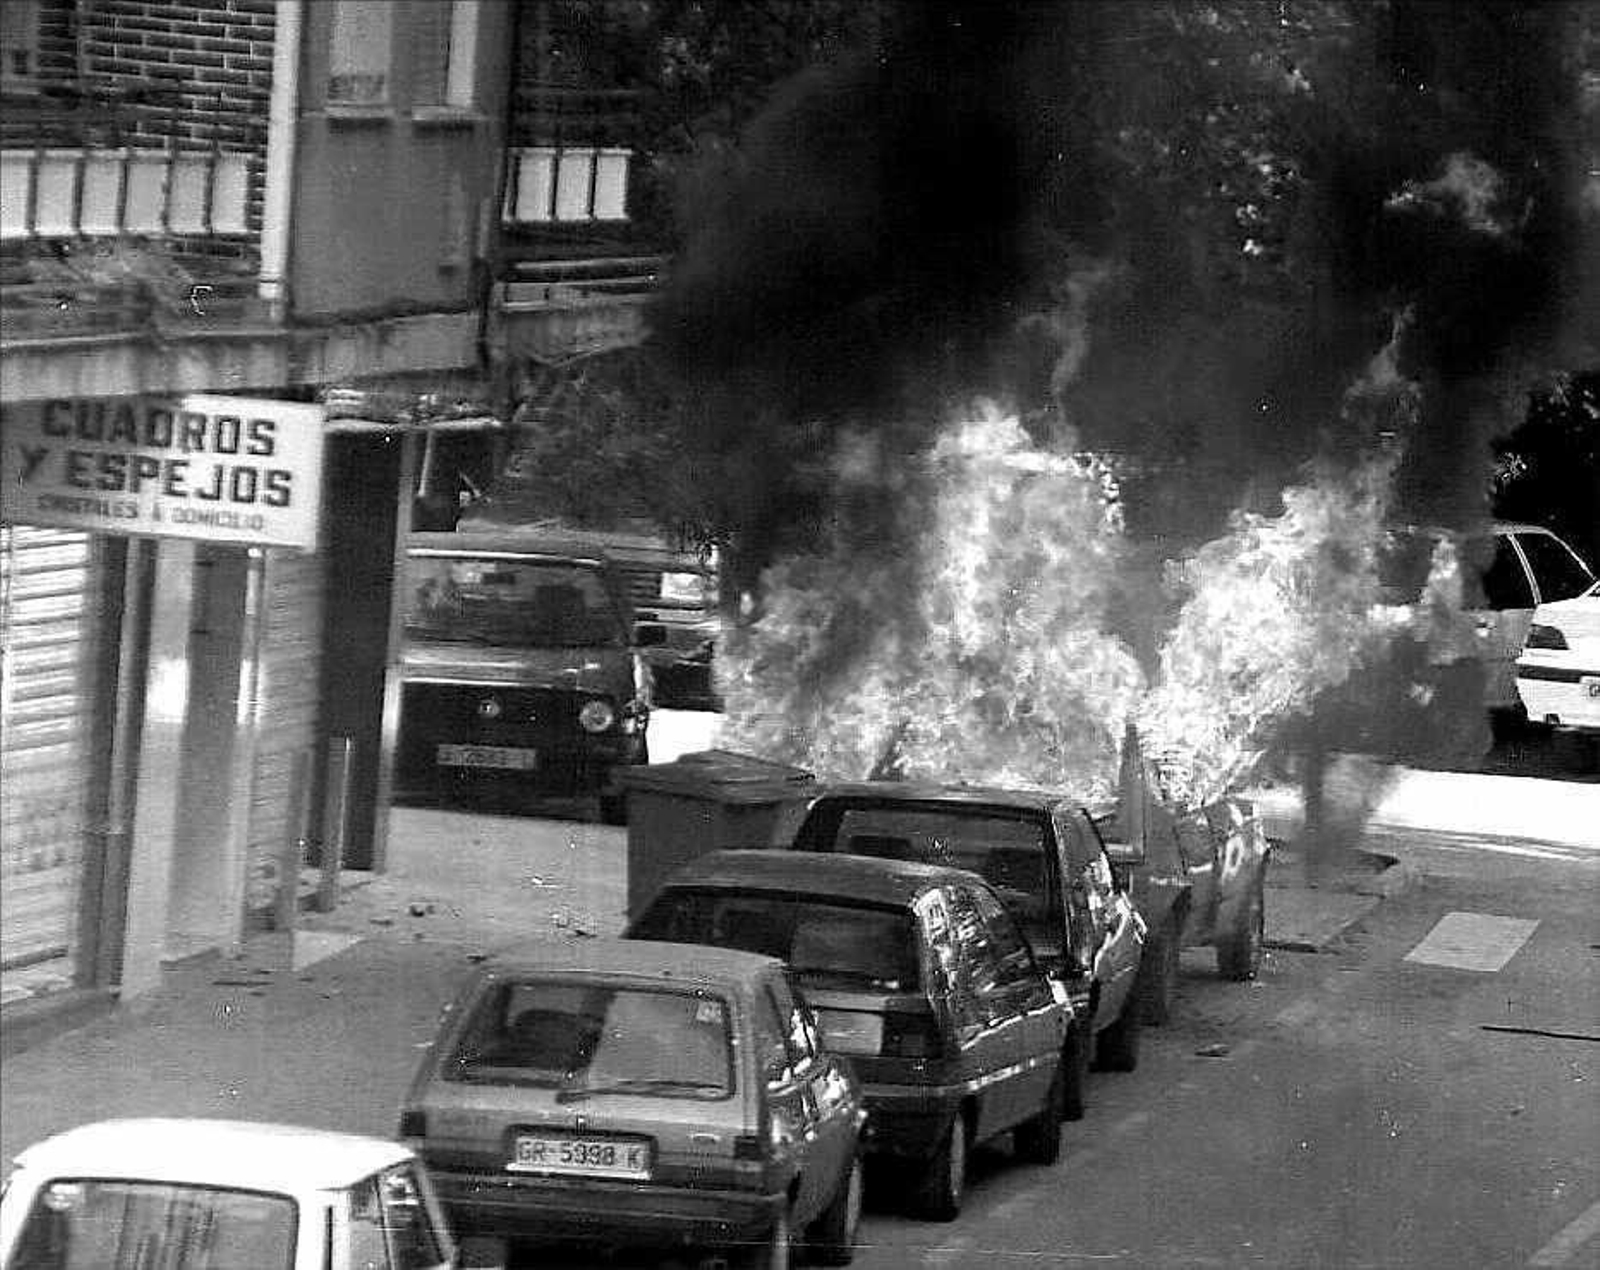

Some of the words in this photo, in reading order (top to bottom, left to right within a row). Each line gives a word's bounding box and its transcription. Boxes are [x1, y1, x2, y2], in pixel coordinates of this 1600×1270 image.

[42, 399, 276, 456] CUADROS
[20, 449, 49, 483] Y
[66, 451, 292, 506] ESPEJOS
